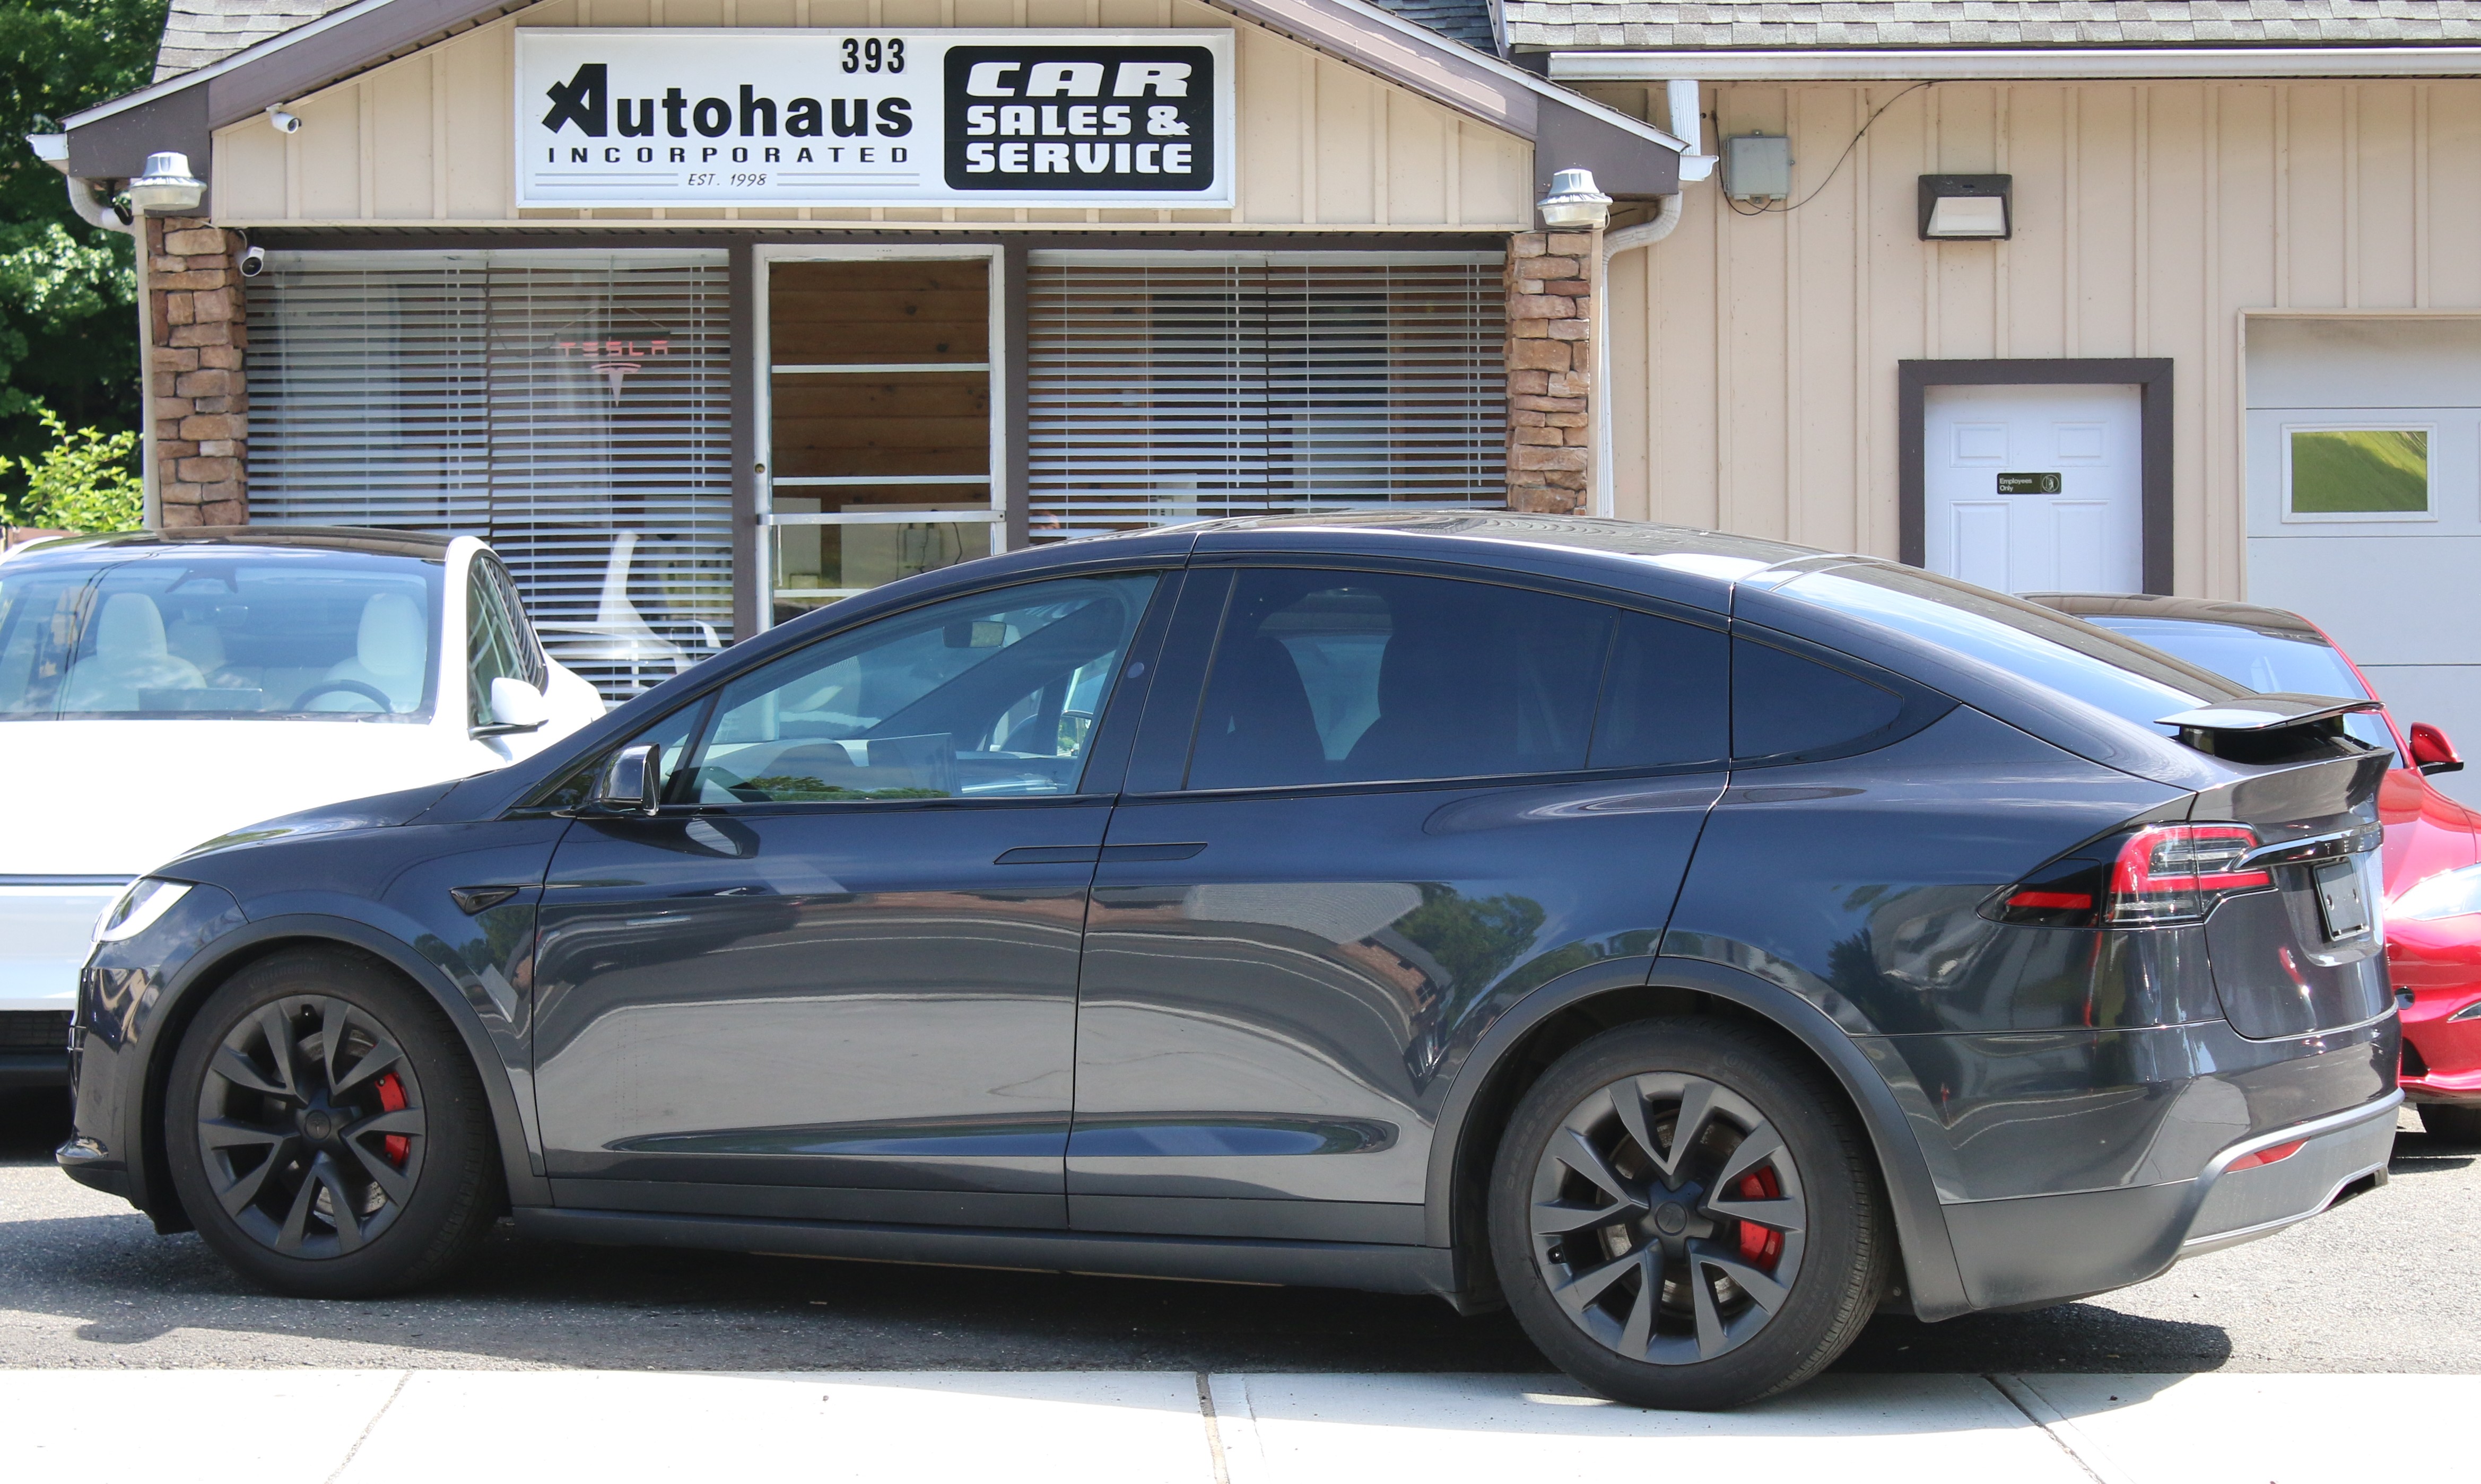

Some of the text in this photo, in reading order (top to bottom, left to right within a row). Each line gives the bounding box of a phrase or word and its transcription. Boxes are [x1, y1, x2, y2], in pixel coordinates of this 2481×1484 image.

[842, 38, 906, 74] 393
[966, 62, 1192, 97] CAR
[541, 63, 913, 138] Autohaus
[967, 105, 1190, 136] SALES &
[548, 147, 909, 163] INCORPORATED
[966, 142, 1192, 174] SERVICE
[688, 173, 768, 187] EST. 1998
[560, 341, 668, 357] TESLA
